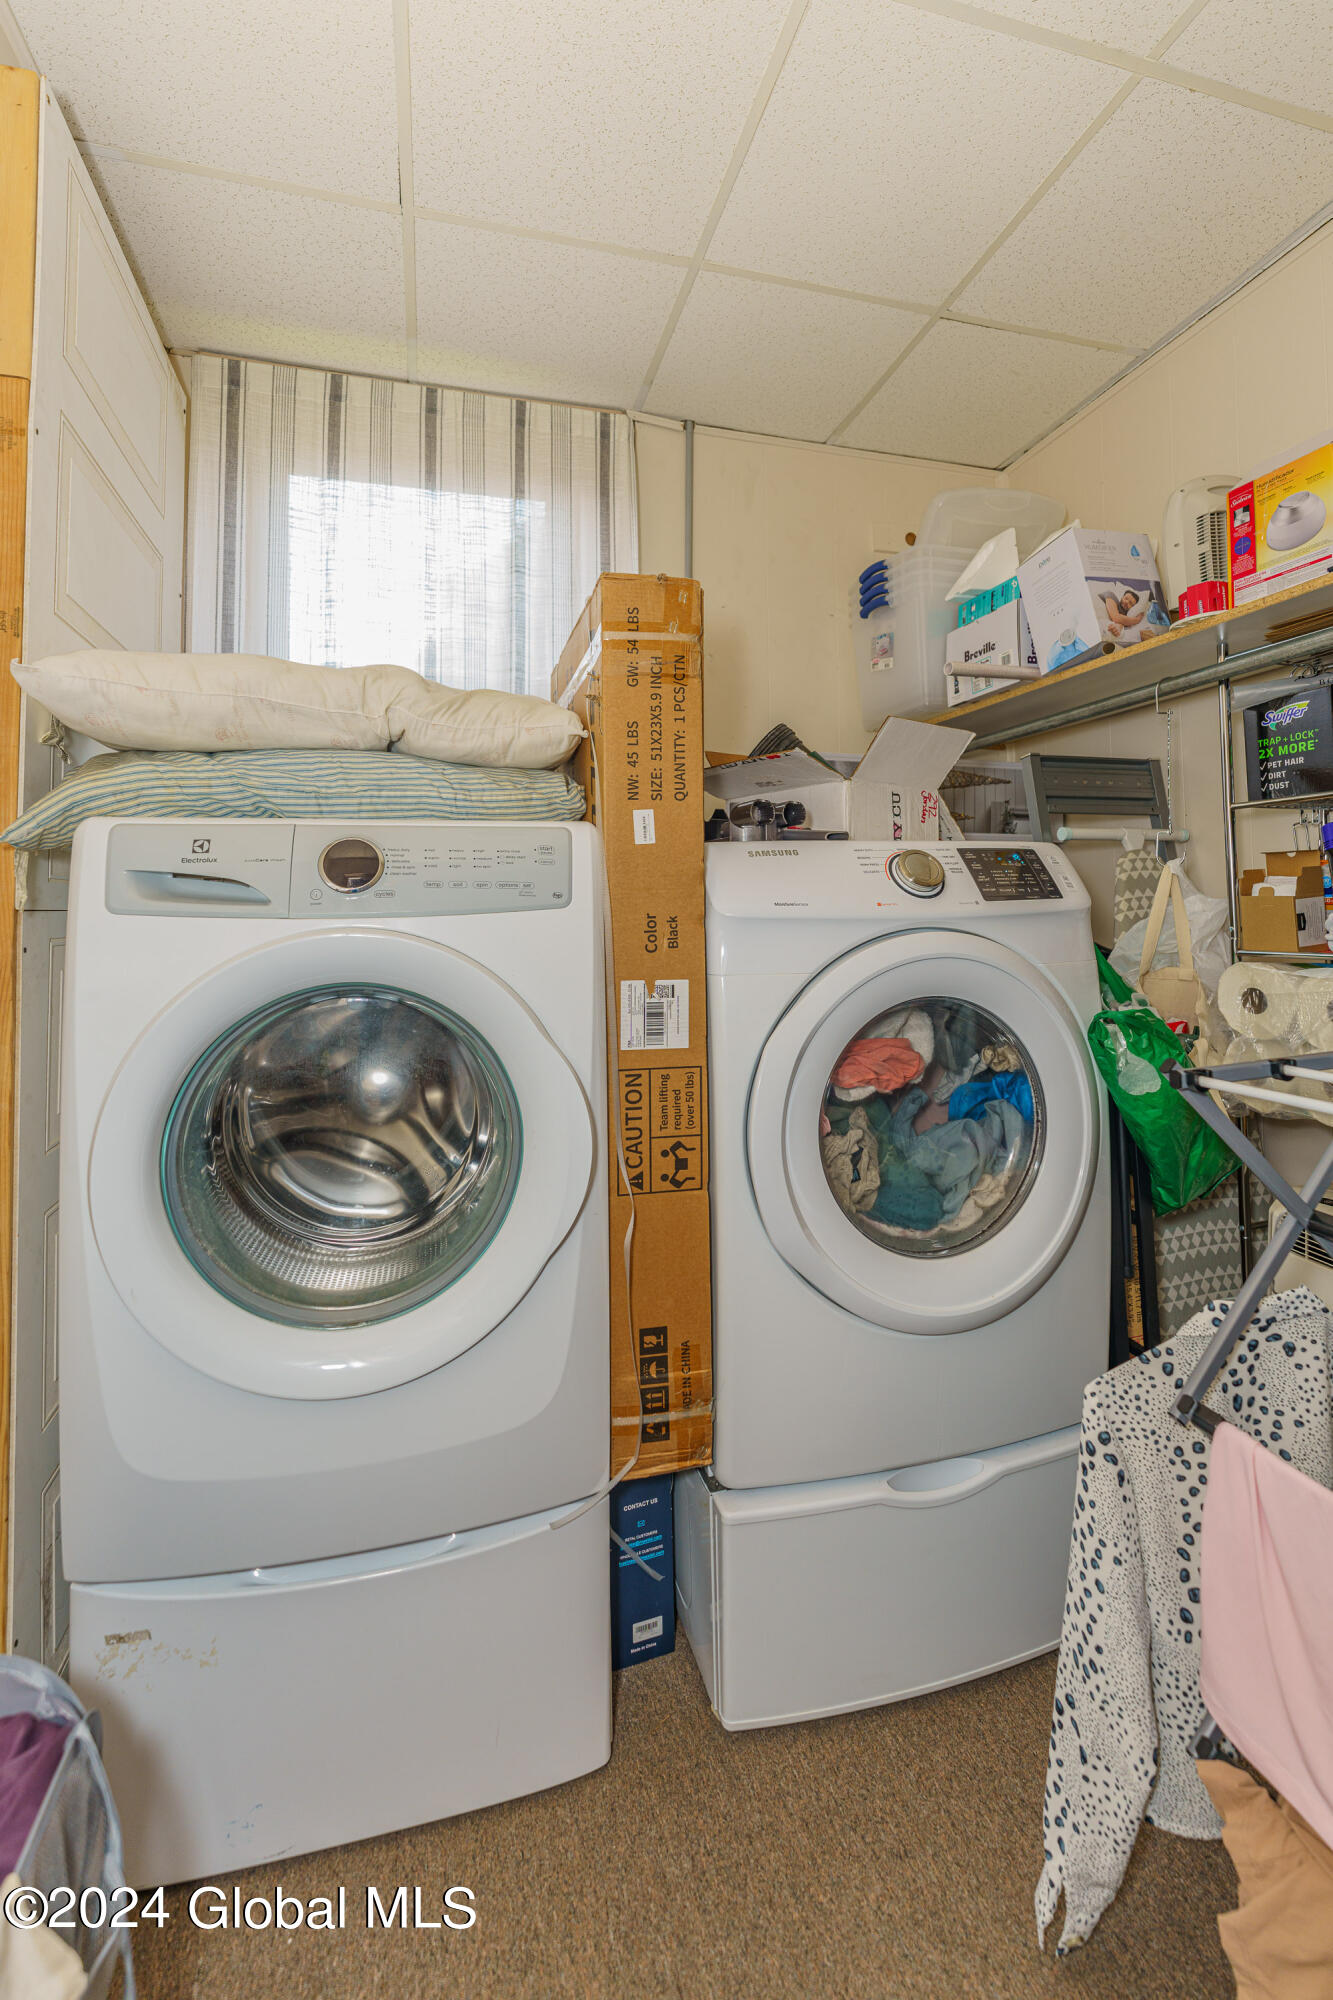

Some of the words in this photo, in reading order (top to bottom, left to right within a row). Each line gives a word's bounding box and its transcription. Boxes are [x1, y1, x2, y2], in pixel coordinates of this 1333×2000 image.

[627, 607, 639, 631] LBS
[627, 640, 639, 654] 54
[964, 641, 997, 663] Breville
[626, 661, 639, 687] GW:
[650, 656, 663, 689] INCH
[673, 654, 688, 712] PCS/CTN
[650, 692, 663, 761] 51X23X5.9
[674, 716, 686, 724] 1
[1262, 706, 1309, 727] Swiffer
[627, 721, 639, 746] LBS
[1258, 736, 1282, 748] TRAP
[627, 752, 639, 768] 45
[1258, 747, 1274, 760] 2X
[1267, 760, 1283, 769] PET
[1284, 756, 1305, 767] HAIR
[674, 730, 689, 802] QUANTITY:
[1268, 770, 1287, 780] DIRT
[627, 774, 639, 800] NW:
[650, 768, 663, 801] SIZE:
[1268, 781, 1290, 791] DUST
[747, 849, 799, 857] SAMSUNG
[643, 913, 658, 953] Color
[667, 915, 679, 949] Black
[659, 1073, 671, 1103] lifting
[684, 1071, 696, 1087] lbs)
[685, 1091, 695, 1106] 50
[624, 1073, 643, 1169] CAUTION
[660, 1107, 669, 1131] Team
[673, 1089, 683, 1131] required
[684, 1110, 696, 1130] (over
[680, 1340, 691, 1375] CHINA
[681, 1377, 691, 1389] IN
[682, 1390, 692, 1411] ADE
[624, 1500, 649, 1512] CONTACT
[650, 1497, 658, 1505] US
